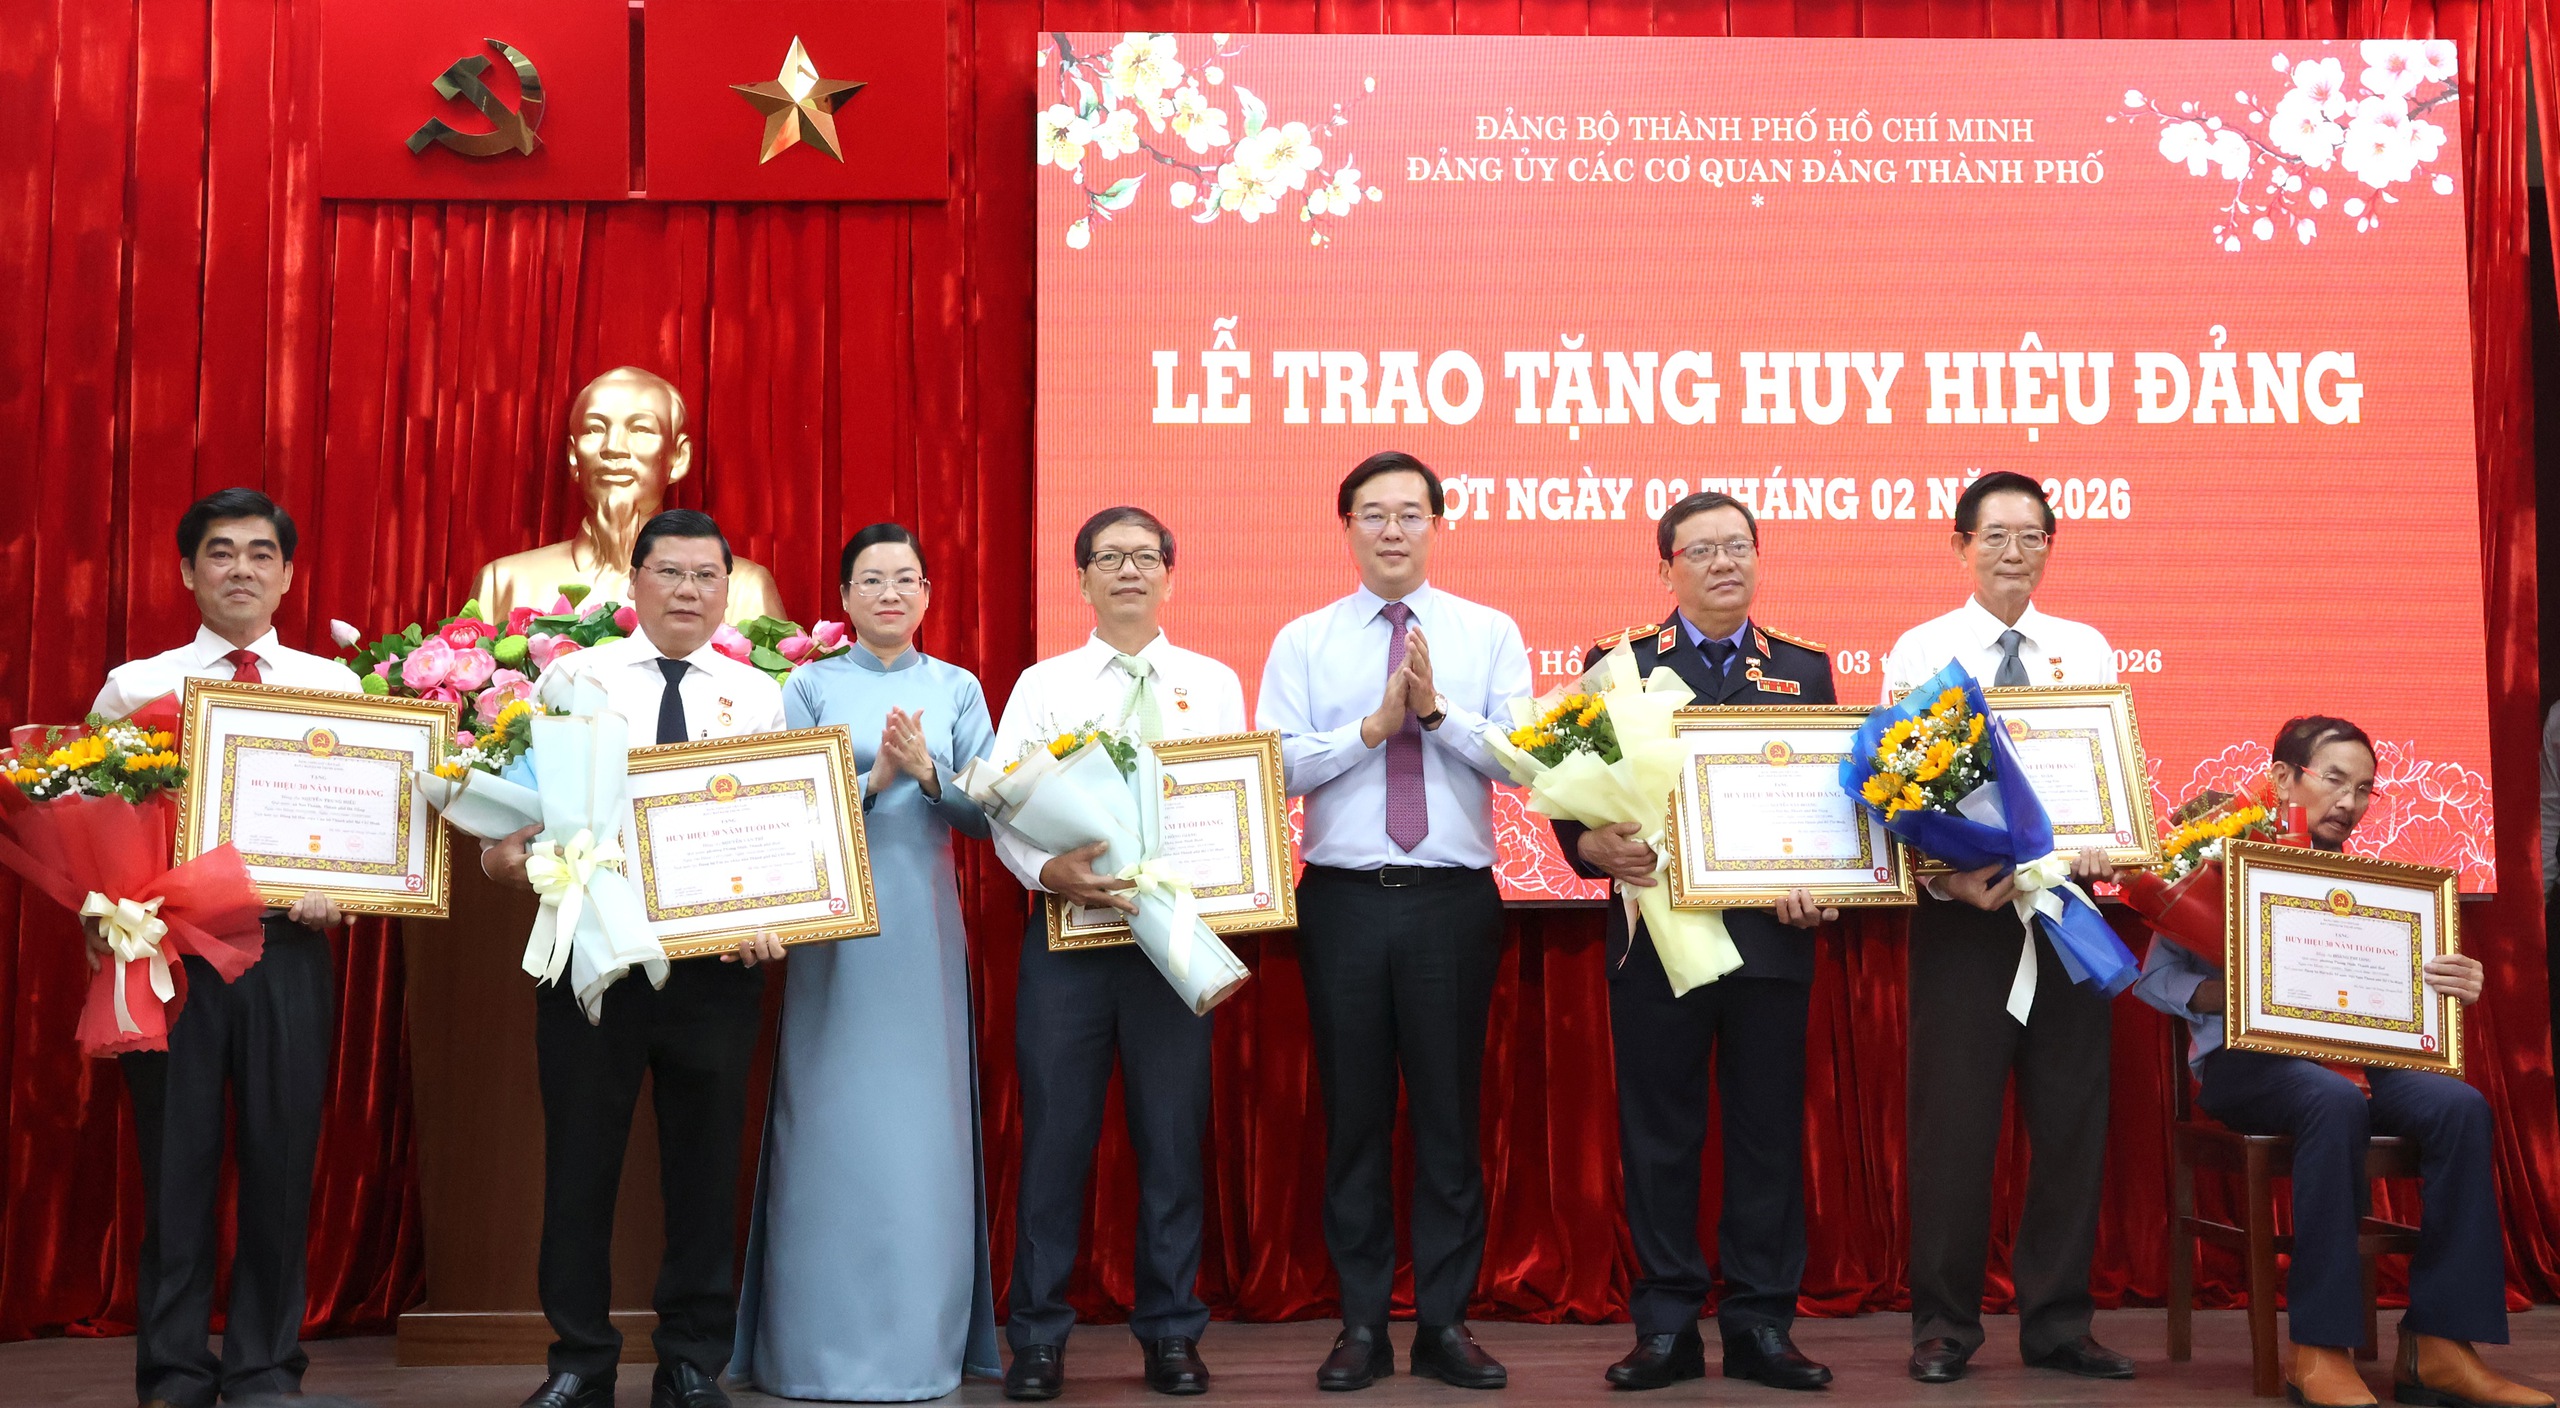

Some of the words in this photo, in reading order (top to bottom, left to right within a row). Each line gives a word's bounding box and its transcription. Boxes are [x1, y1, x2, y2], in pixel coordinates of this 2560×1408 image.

[1475, 106, 1568, 141] ĐẢNG
[1576, 110, 1620, 147] BỘ
[1627, 111, 1743, 141] THÀNH
[1750, 107, 1818, 142] PHỐ
[1826, 108, 1873, 142] HỒ
[1882, 111, 1939, 142] CHÍ
[1946, 118, 2035, 143] MINH
[1406, 147, 1503, 182] ĐẢNG
[1511, 147, 1559, 182] ỦY
[1567, 150, 1635, 183] CÁC
[1644, 154, 1691, 183] CƠ
[1699, 157, 1794, 188] QUAN
[1801, 150, 1898, 184] ĐẢNG
[1905, 151, 2024, 184] THÀNH
[2033, 149, 2105, 184] PHỐ
[1152, 315, 1251, 424] LỄ
[1272, 349, 1485, 425] TRAO
[1504, 333, 1721, 441] TẶNG
[1740, 351, 1905, 425] HUY
[1924, 331, 2114, 442] HIỆU
[2134, 324, 2364, 425] ĐẢNG
[1440, 473, 1495, 530] ỢT
[1505, 465, 1633, 521] NGÀY
[1871, 478, 1916, 520] 02
[2041, 477, 2131, 520] 2026
[1539, 645, 1584, 676] Hồ
[1837, 650, 1871, 675] 03
[2112, 648, 2163, 673] 026
[2117, 832, 2130, 843] 15
[407, 877, 421, 889] 23
[1876, 869, 1889, 880] 19
[830, 900, 844, 911] 22
[1255, 894, 1268, 905] 20
[2422, 1037, 2433, 1049] 14
